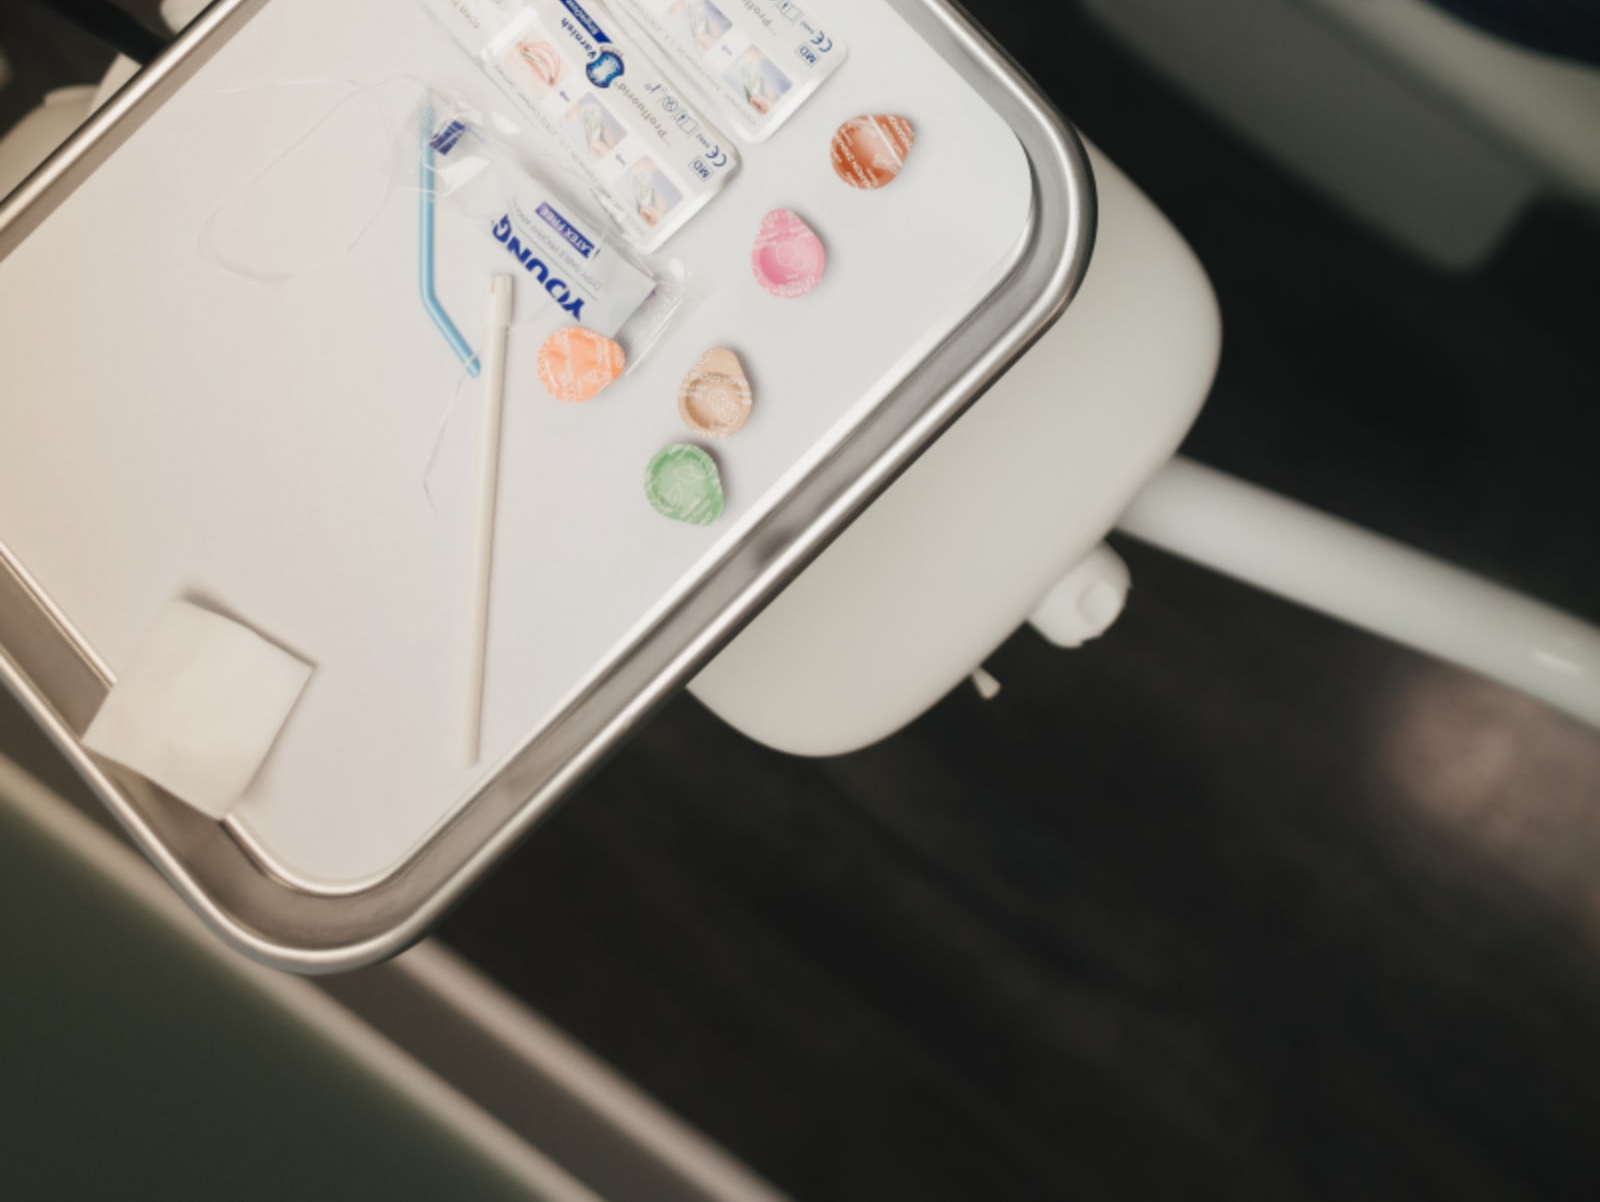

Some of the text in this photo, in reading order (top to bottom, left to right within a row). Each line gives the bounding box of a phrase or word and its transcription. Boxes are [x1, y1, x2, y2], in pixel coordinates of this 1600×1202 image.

[558, 16, 599, 60] Varnish
[690, 158, 712, 180] MD
[540, 206, 594, 255] LATEX FREE
[490, 213, 587, 322] YOUNG
